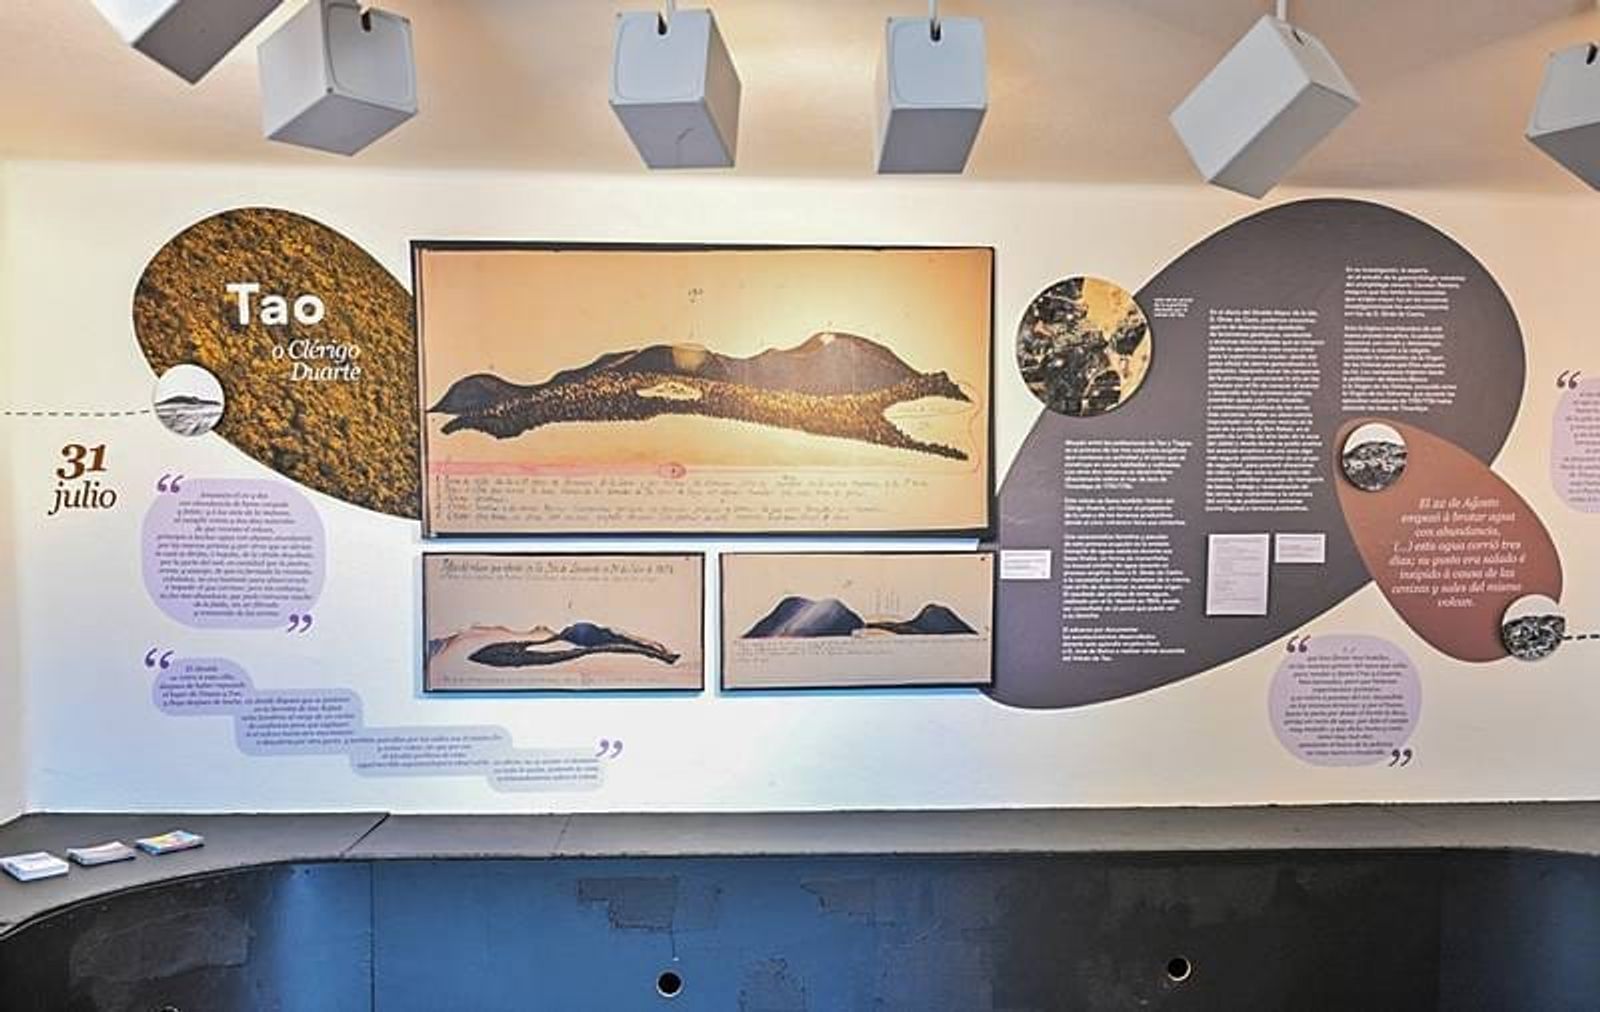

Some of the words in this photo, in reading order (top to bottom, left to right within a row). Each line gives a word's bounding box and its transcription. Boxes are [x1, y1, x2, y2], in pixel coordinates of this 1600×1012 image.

[225, 281, 326, 326] Tao
[271, 344, 285, 360] o
[287, 337, 362, 364] Clérigo
[290, 361, 362, 382] Duarte
[56, 443, 107, 480] 31
[47, 480, 118, 516] julio
[1447, 497, 1461, 509] de
[1487, 513, 1516, 525] agua
[1414, 529, 1433, 538] con
[1438, 543, 1465, 555] agua
[1501, 541, 1520, 551] tres
[1484, 567, 1498, 578] de
[1500, 566, 1515, 577] las
[1431, 585, 1439, 596] y
[1468, 580, 1485, 593] del
